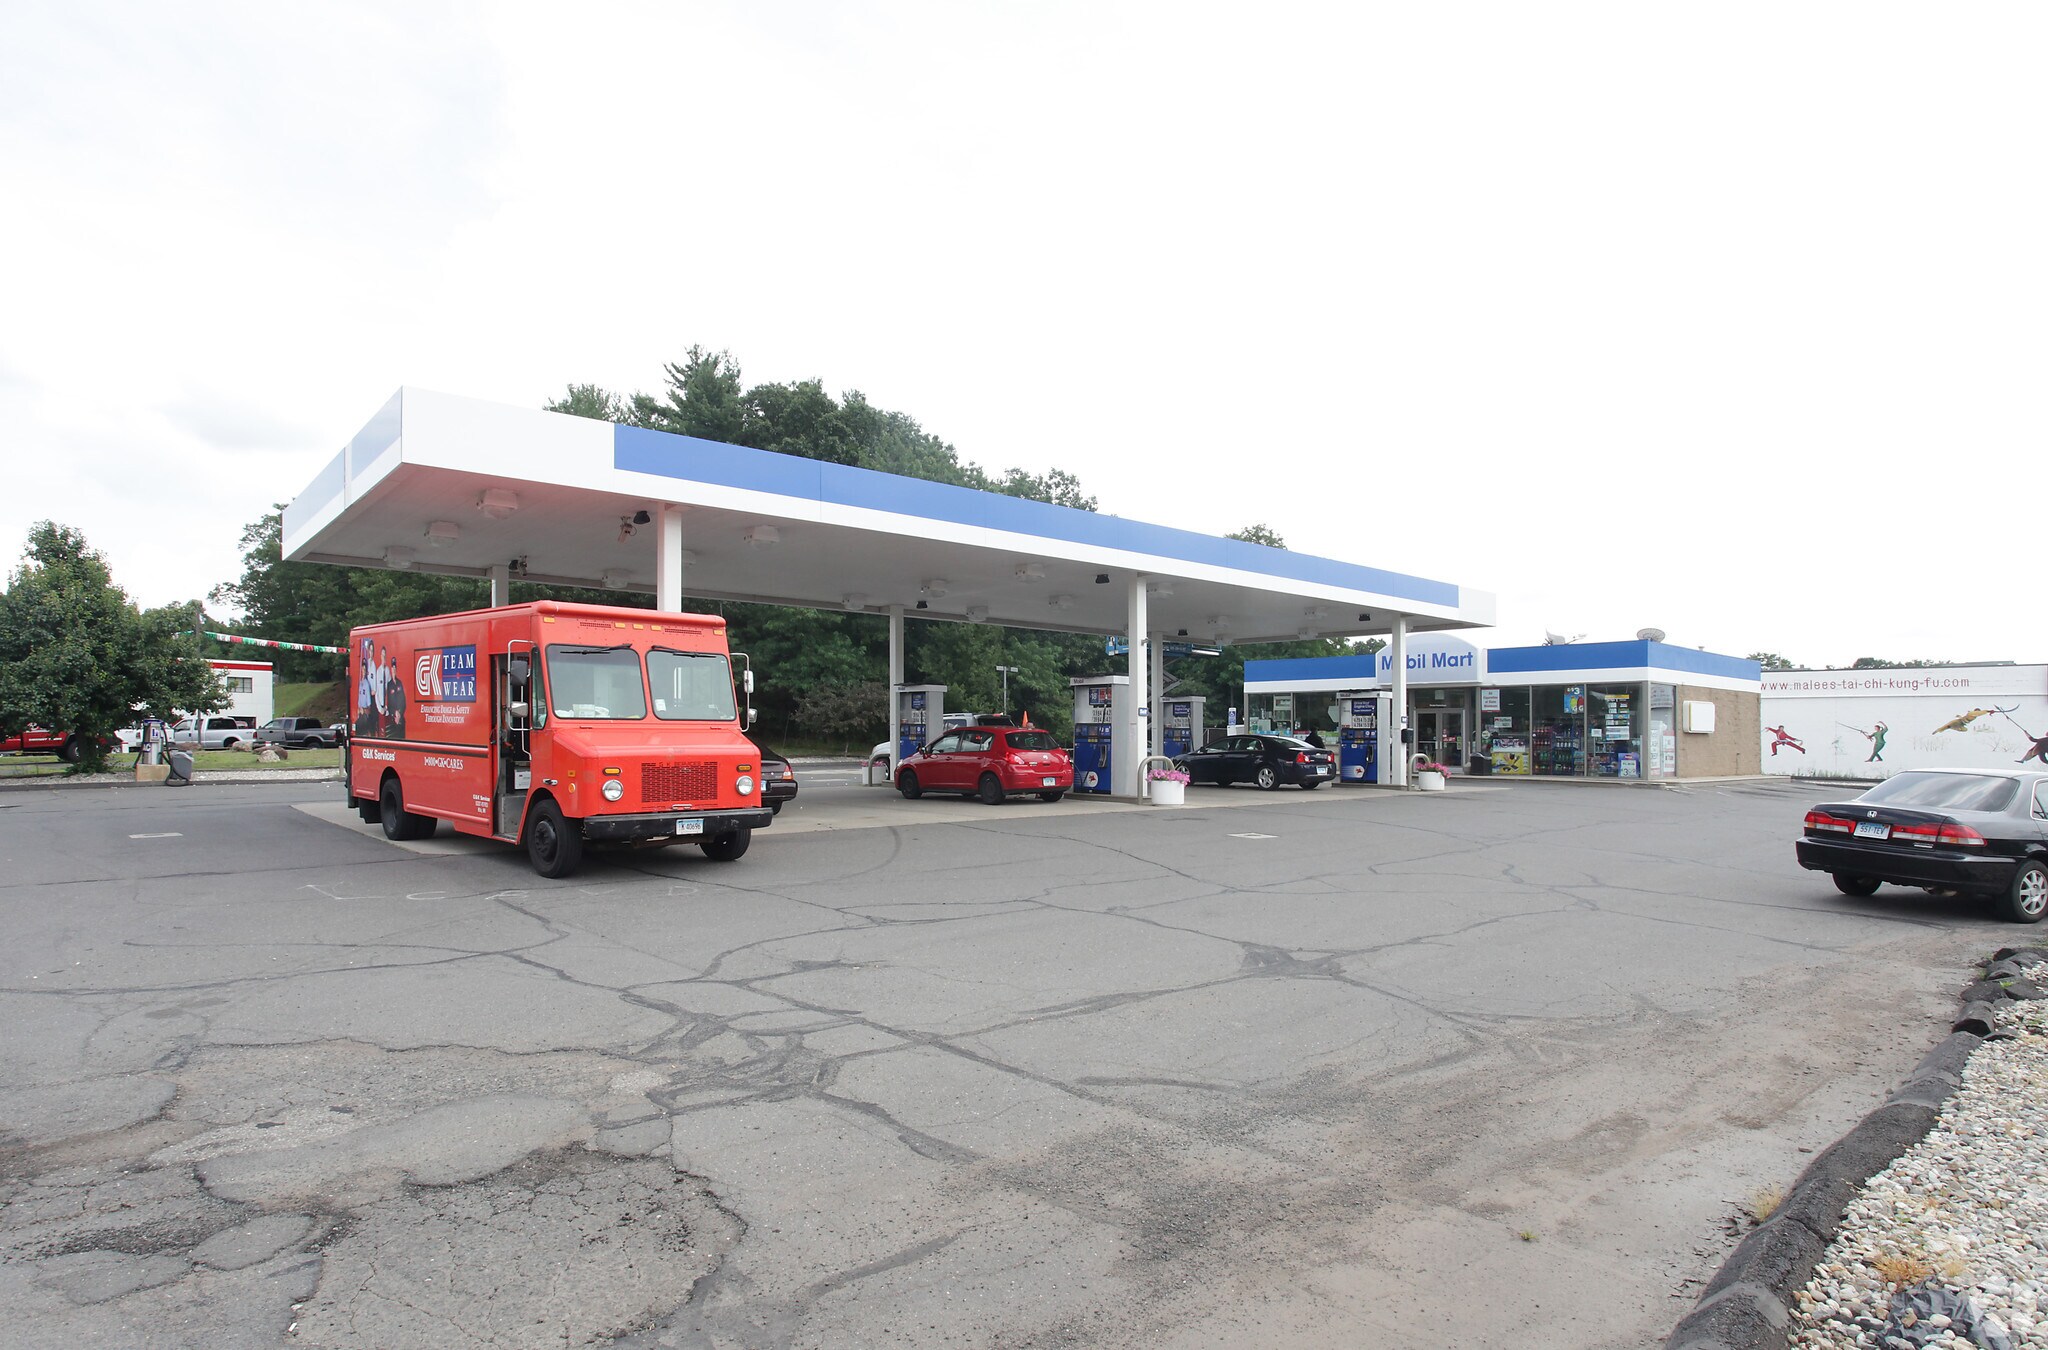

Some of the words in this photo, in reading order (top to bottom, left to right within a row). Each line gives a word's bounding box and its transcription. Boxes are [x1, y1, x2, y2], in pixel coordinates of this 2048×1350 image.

[443, 653, 474, 670] TEAM
[1381, 654, 1426, 670] Mbil
[1432, 652, 1474, 668] Mart
[443, 681, 475, 696] WEAR
[1760, 677, 1970, 691] www.malees-tai-chi-kung-fu.com
[362, 749, 374, 759] G&K
[374, 750, 396, 761] Services
